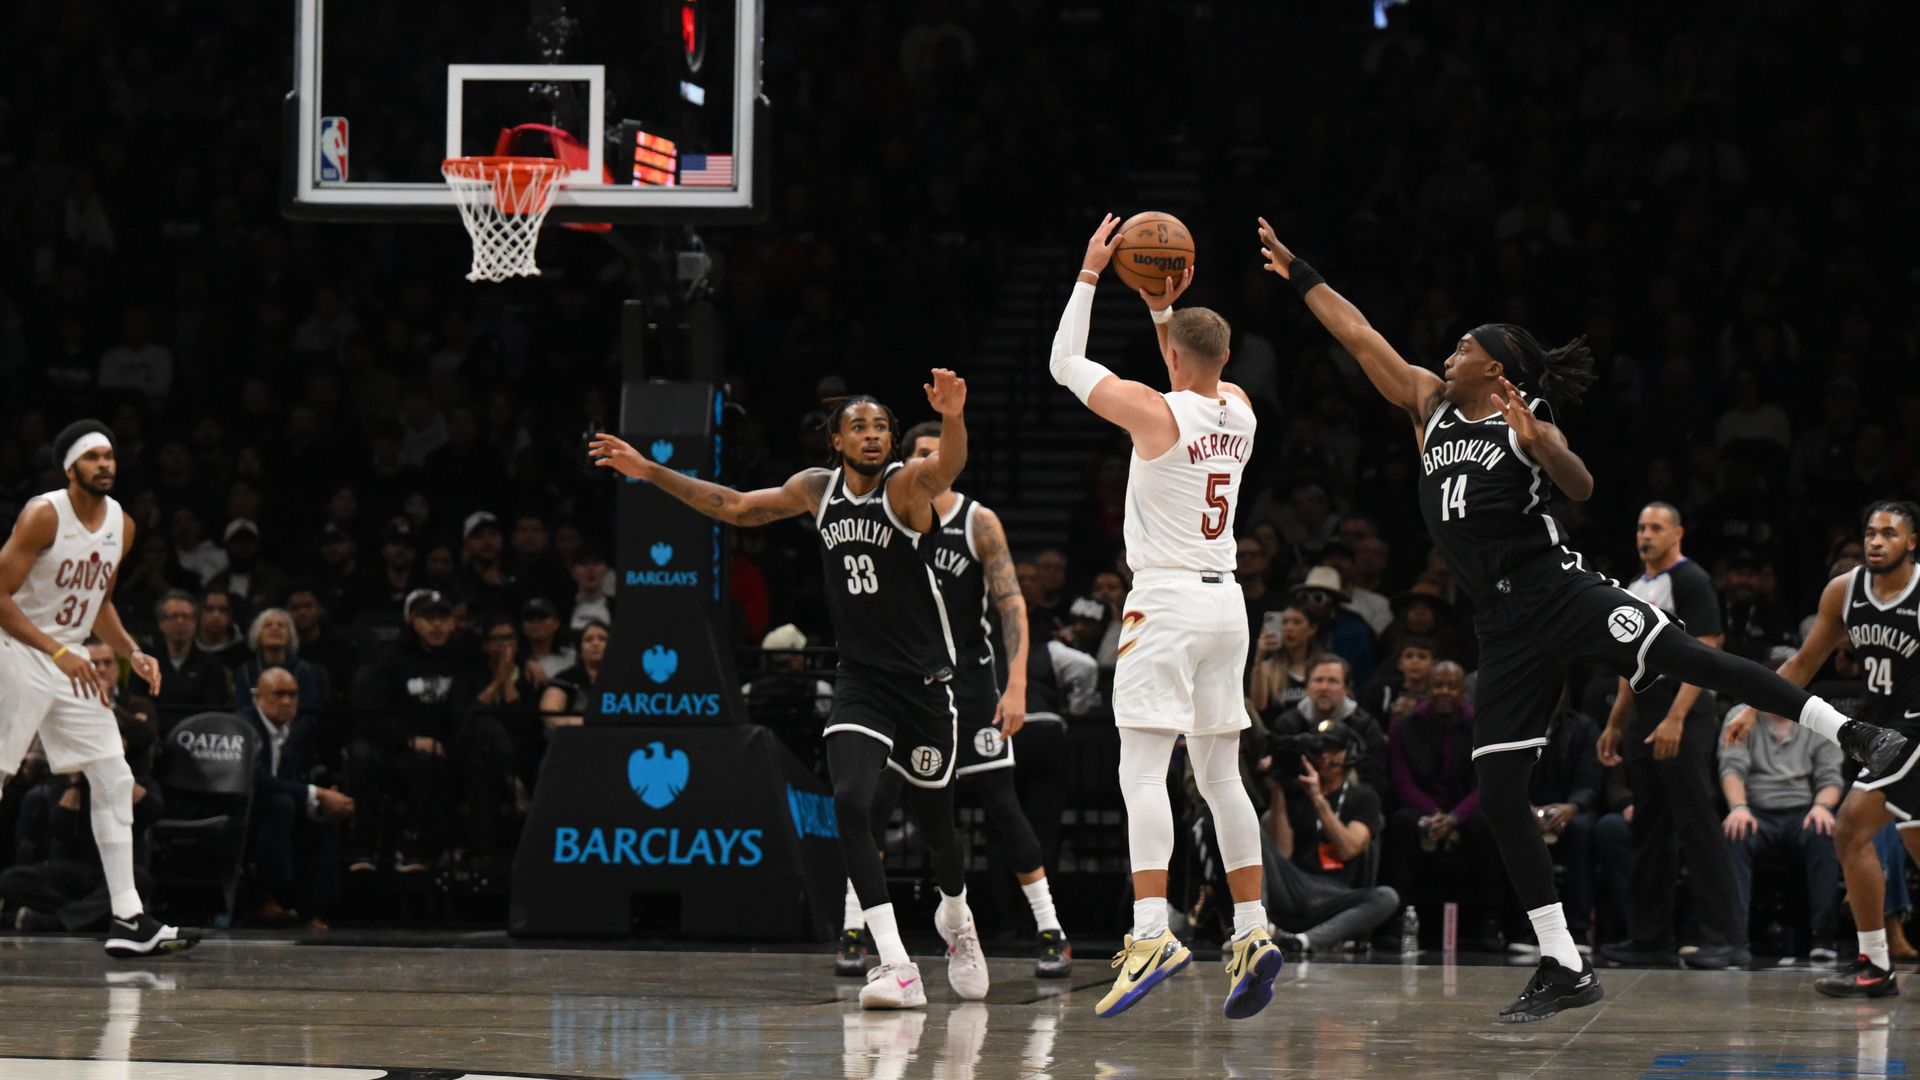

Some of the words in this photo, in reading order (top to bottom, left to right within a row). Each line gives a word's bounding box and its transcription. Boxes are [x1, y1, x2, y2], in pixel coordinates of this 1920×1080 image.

[1133, 253, 1186, 272] Wilson
[1422, 439, 1506, 476] BROOKLYN
[1201, 473, 1231, 540] 5
[1440, 474, 1468, 522] 14
[820, 518, 894, 550] BROOKLYN
[55, 559, 112, 590] CAVS
[625, 570, 699, 587] BARCLAYS
[843, 554, 879, 595] 33
[55, 594, 89, 627] 31
[1864, 656, 1894, 696] 24
[601, 692, 721, 716] BARCLAYS
[176, 730, 245, 752] QATAR
[553, 826, 765, 866] BARCLAYS
